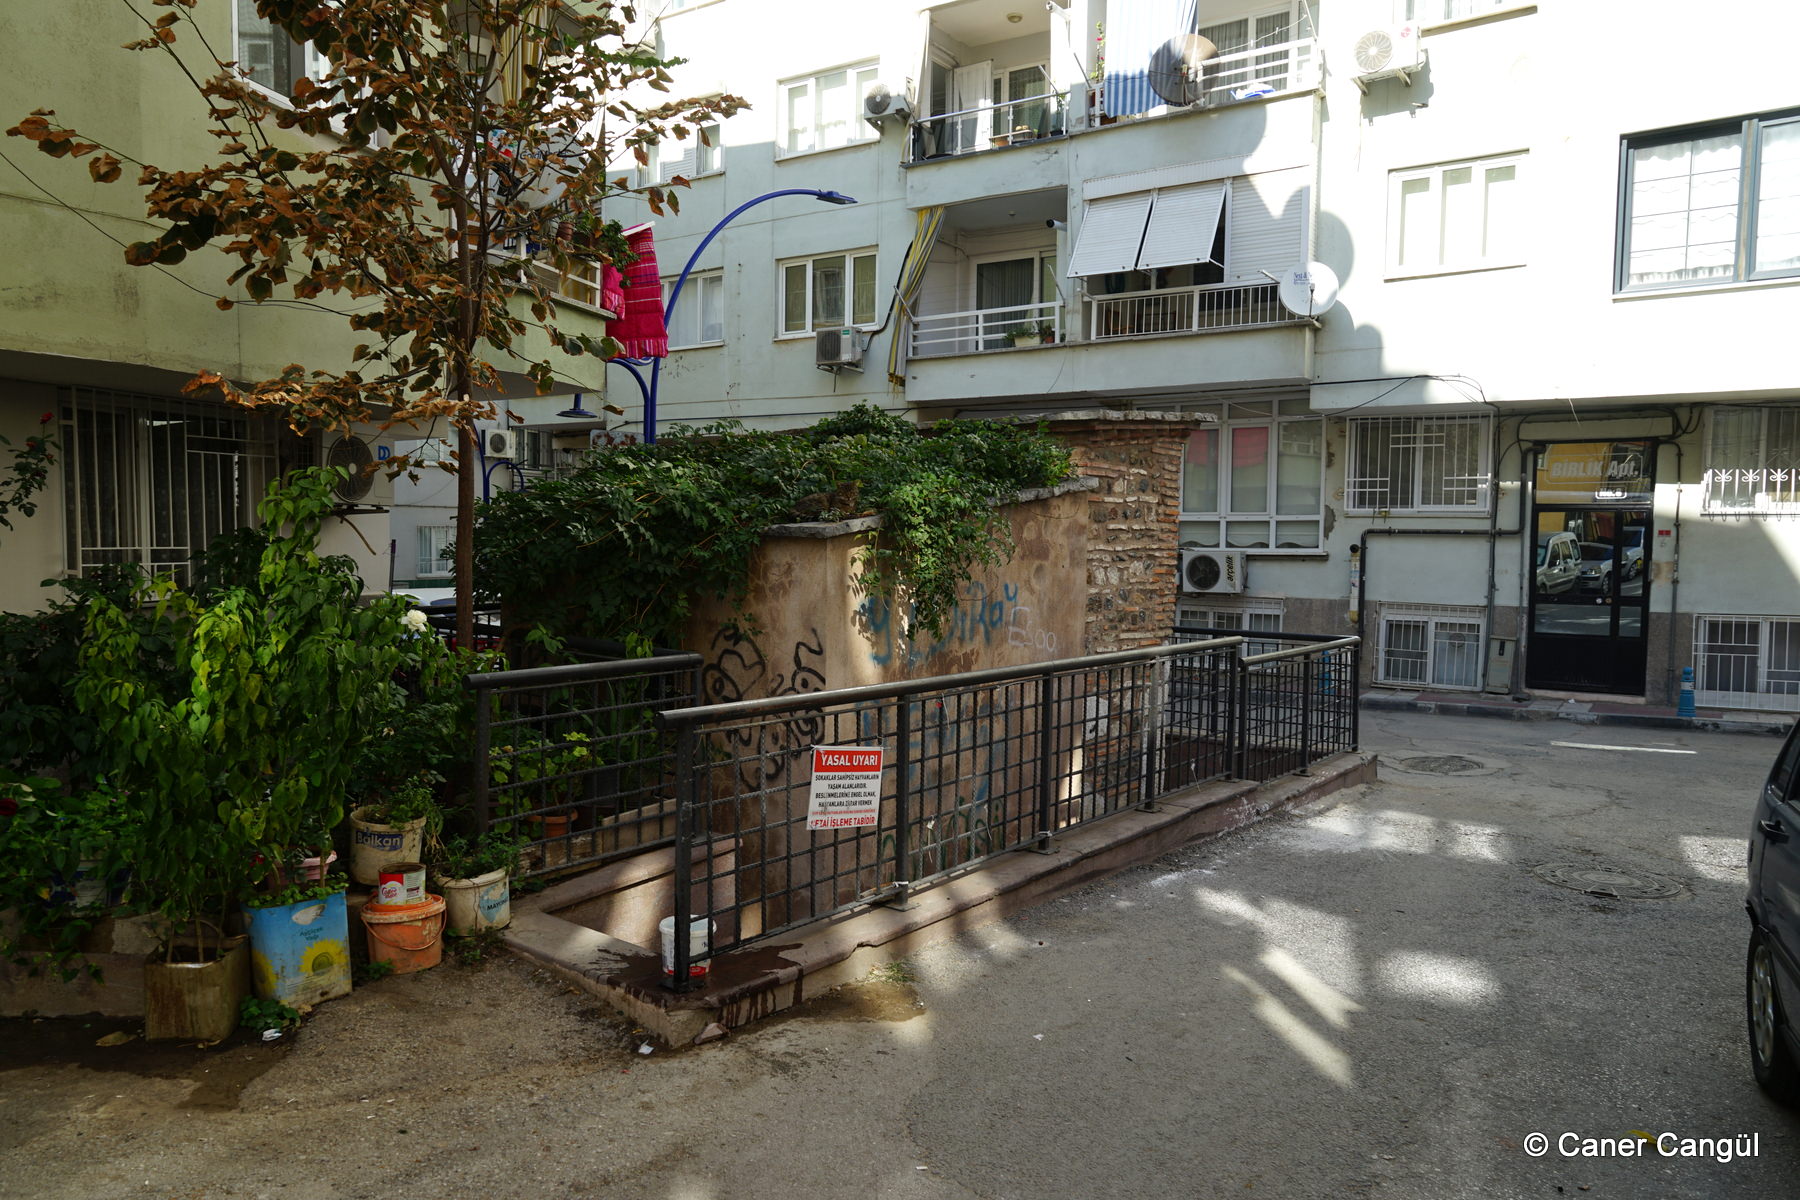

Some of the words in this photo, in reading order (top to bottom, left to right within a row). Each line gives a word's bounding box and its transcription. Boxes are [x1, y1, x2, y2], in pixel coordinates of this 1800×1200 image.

[1551, 459, 1603, 478] BİRLİK
[1607, 460, 1639, 479] Apt.
[822, 755, 850, 766] YASAL
[853, 755, 878, 766] UYARI
[837, 773, 854, 781] SAHİPSİZ
[830, 816, 853, 827] İŞLEME
[357, 831, 401, 847] Balkan
